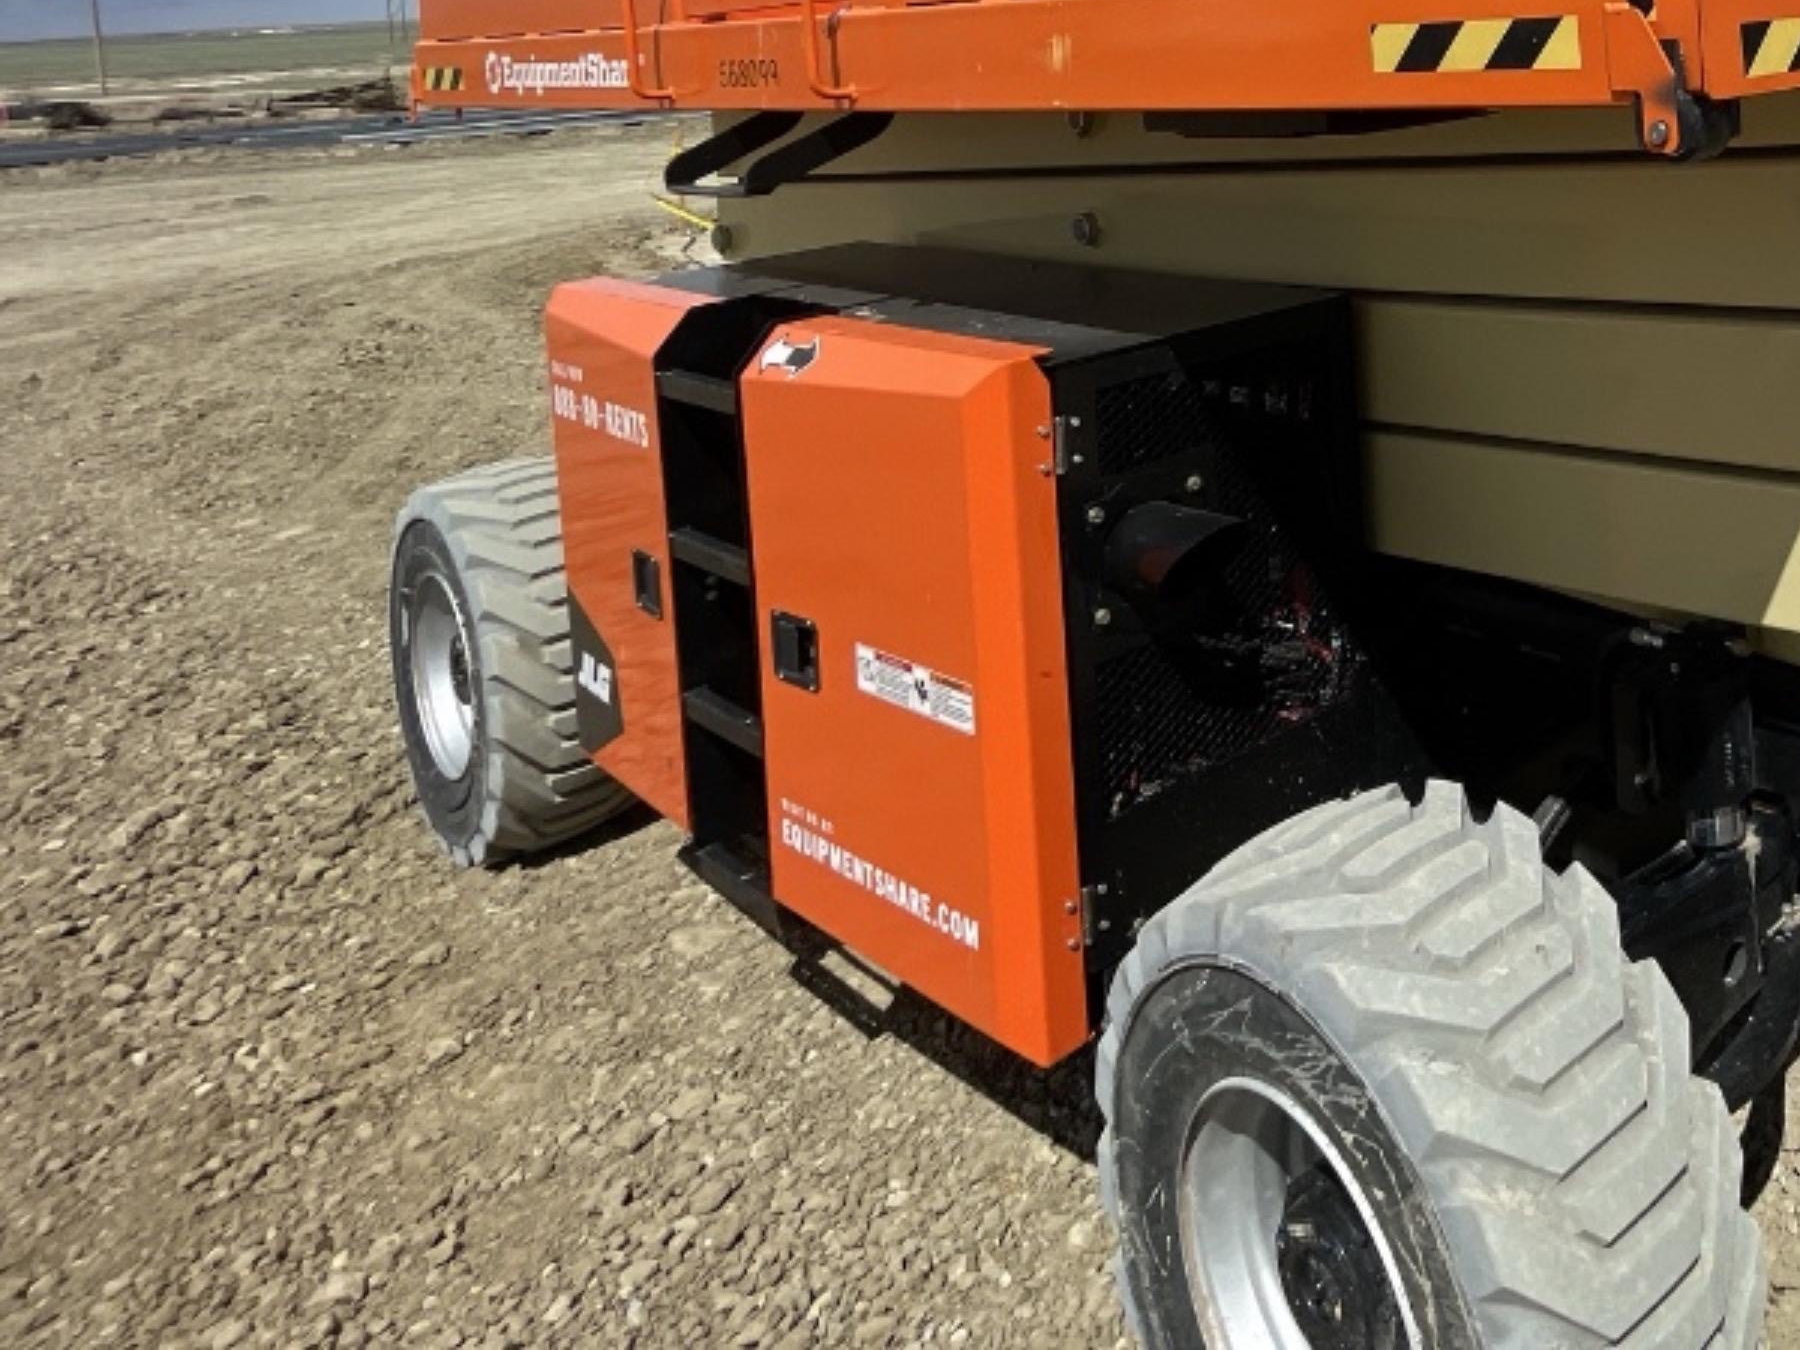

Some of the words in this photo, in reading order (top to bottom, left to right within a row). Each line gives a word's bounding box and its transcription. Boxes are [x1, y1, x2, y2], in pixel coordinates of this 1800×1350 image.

[500, 52, 631, 97] EquipmentShar
[578, 650, 611, 705] JLG
[781, 817, 980, 950] EQUIPMENTSHARE.COM
